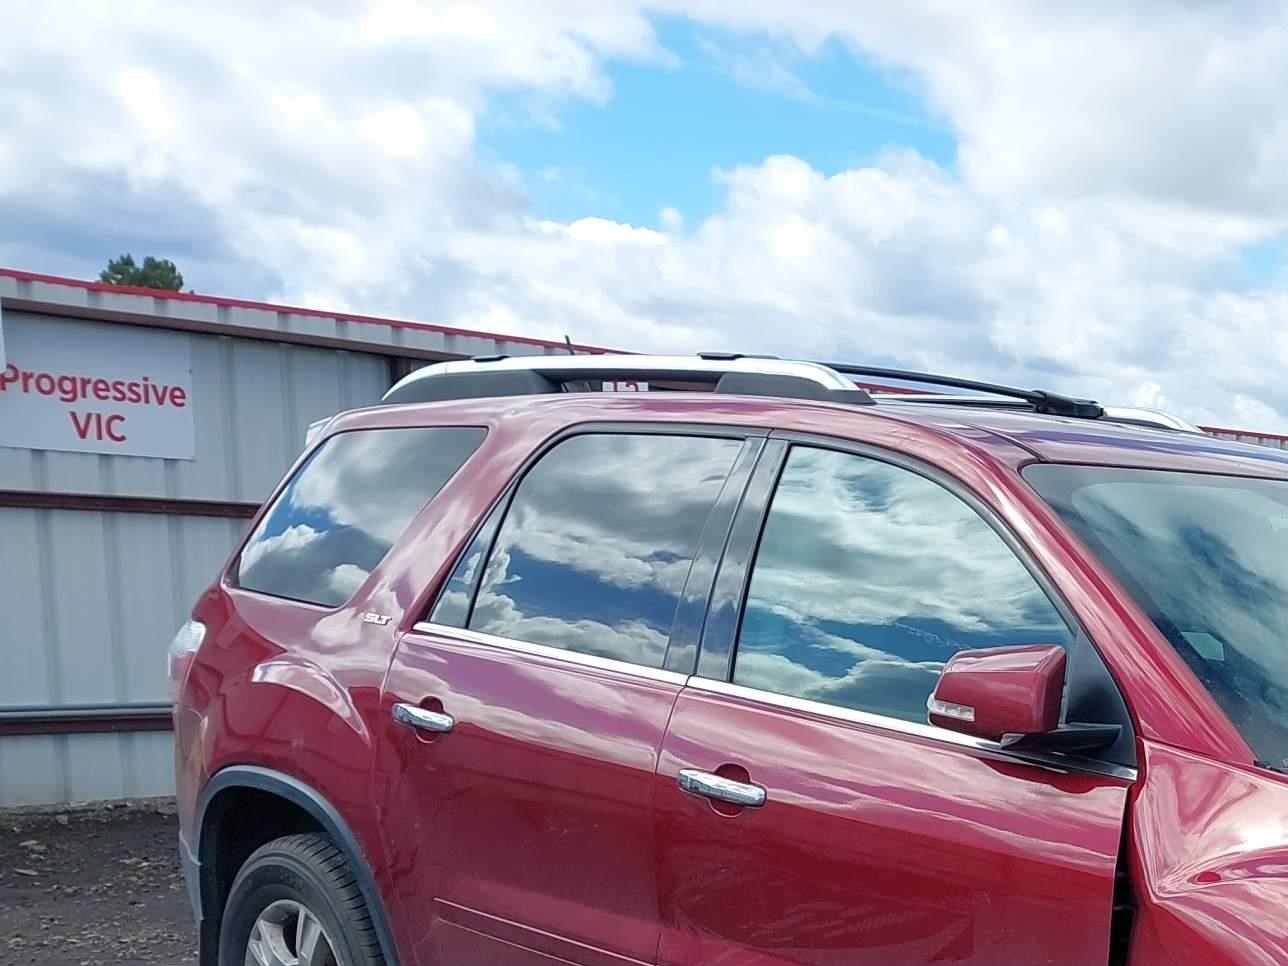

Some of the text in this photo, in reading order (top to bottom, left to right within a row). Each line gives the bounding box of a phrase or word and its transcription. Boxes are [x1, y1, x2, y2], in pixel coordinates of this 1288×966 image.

[0, 363, 187, 408] Progressive
[68, 410, 128, 442] VIC
[363, 612, 392, 626] SLT
